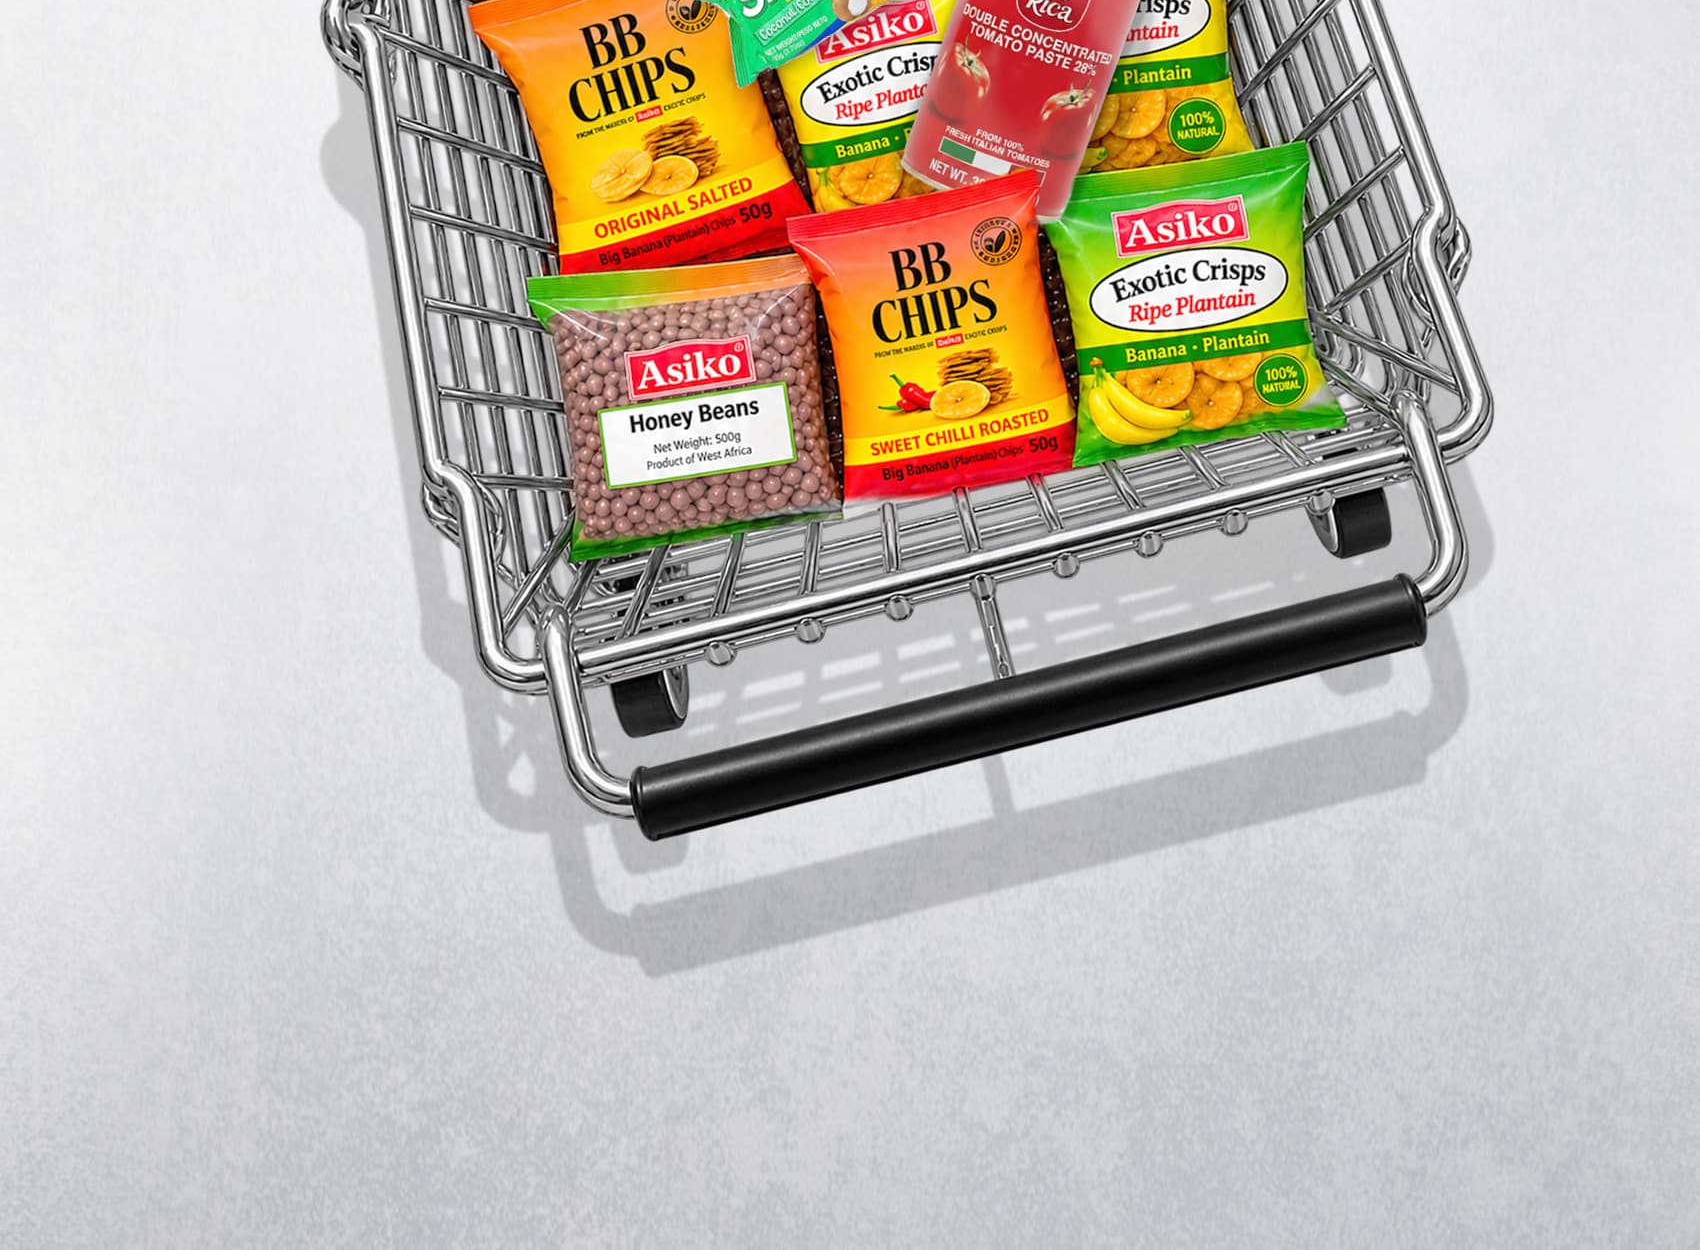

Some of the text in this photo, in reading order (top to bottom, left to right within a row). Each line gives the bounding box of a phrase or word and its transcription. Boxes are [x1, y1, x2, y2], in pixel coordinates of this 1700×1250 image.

[579, 13, 647, 70] BB
[824, 10, 923, 55] Asiko
[962, 3, 1112, 65] DOUBLE CONCENTRATED
[970, 21, 1097, 77] TOMATO PASTE 28%
[1126, 21, 1179, 42] ntain
[569, 47, 695, 123] CHIPS
[816, 52, 937, 104] Exotic Cris
[1124, 65, 1192, 85] Plantain
[835, 83, 928, 121] Ripe Plant
[1180, 111, 1214, 128] 100%
[835, 136, 890, 159] Banana
[945, 126, 1050, 168] FRESH ITALIAN TOMATOES
[976, 129, 1024, 152] FROM 100%
[1177, 126, 1219, 140] NATURAL
[929, 158, 949, 175] NET
[950, 166, 967, 185] WT.
[594, 177, 753, 240] ORIGINAL SALTED
[599, 199, 773, 268] Big Banana (Plantain) Chips 50g
[1126, 209, 1235, 249] Asiko
[889, 241, 952, 293] BB
[1109, 257, 1266, 303] Exotic Crisps
[872, 279, 997, 344] CHIPS
[1129, 289, 1256, 325] Ripe Plantain
[1126, 331, 1270, 364] Banana Plantain
[637, 350, 741, 391] Asiko
[1265, 366, 1298, 381] 100%
[630, 399, 759, 434] Honey Beans
[871, 407, 1049, 457] SWEET CHILLI ROASTED
[647, 445, 752, 471] Product of West Africa
[653, 431, 741, 454] Net Weight: 500g
[882, 466, 904, 483] Big
[907, 459, 949, 475] Banana
[951, 450, 997, 471] (Plantain)
[1029, 436, 1058, 456] 50g
